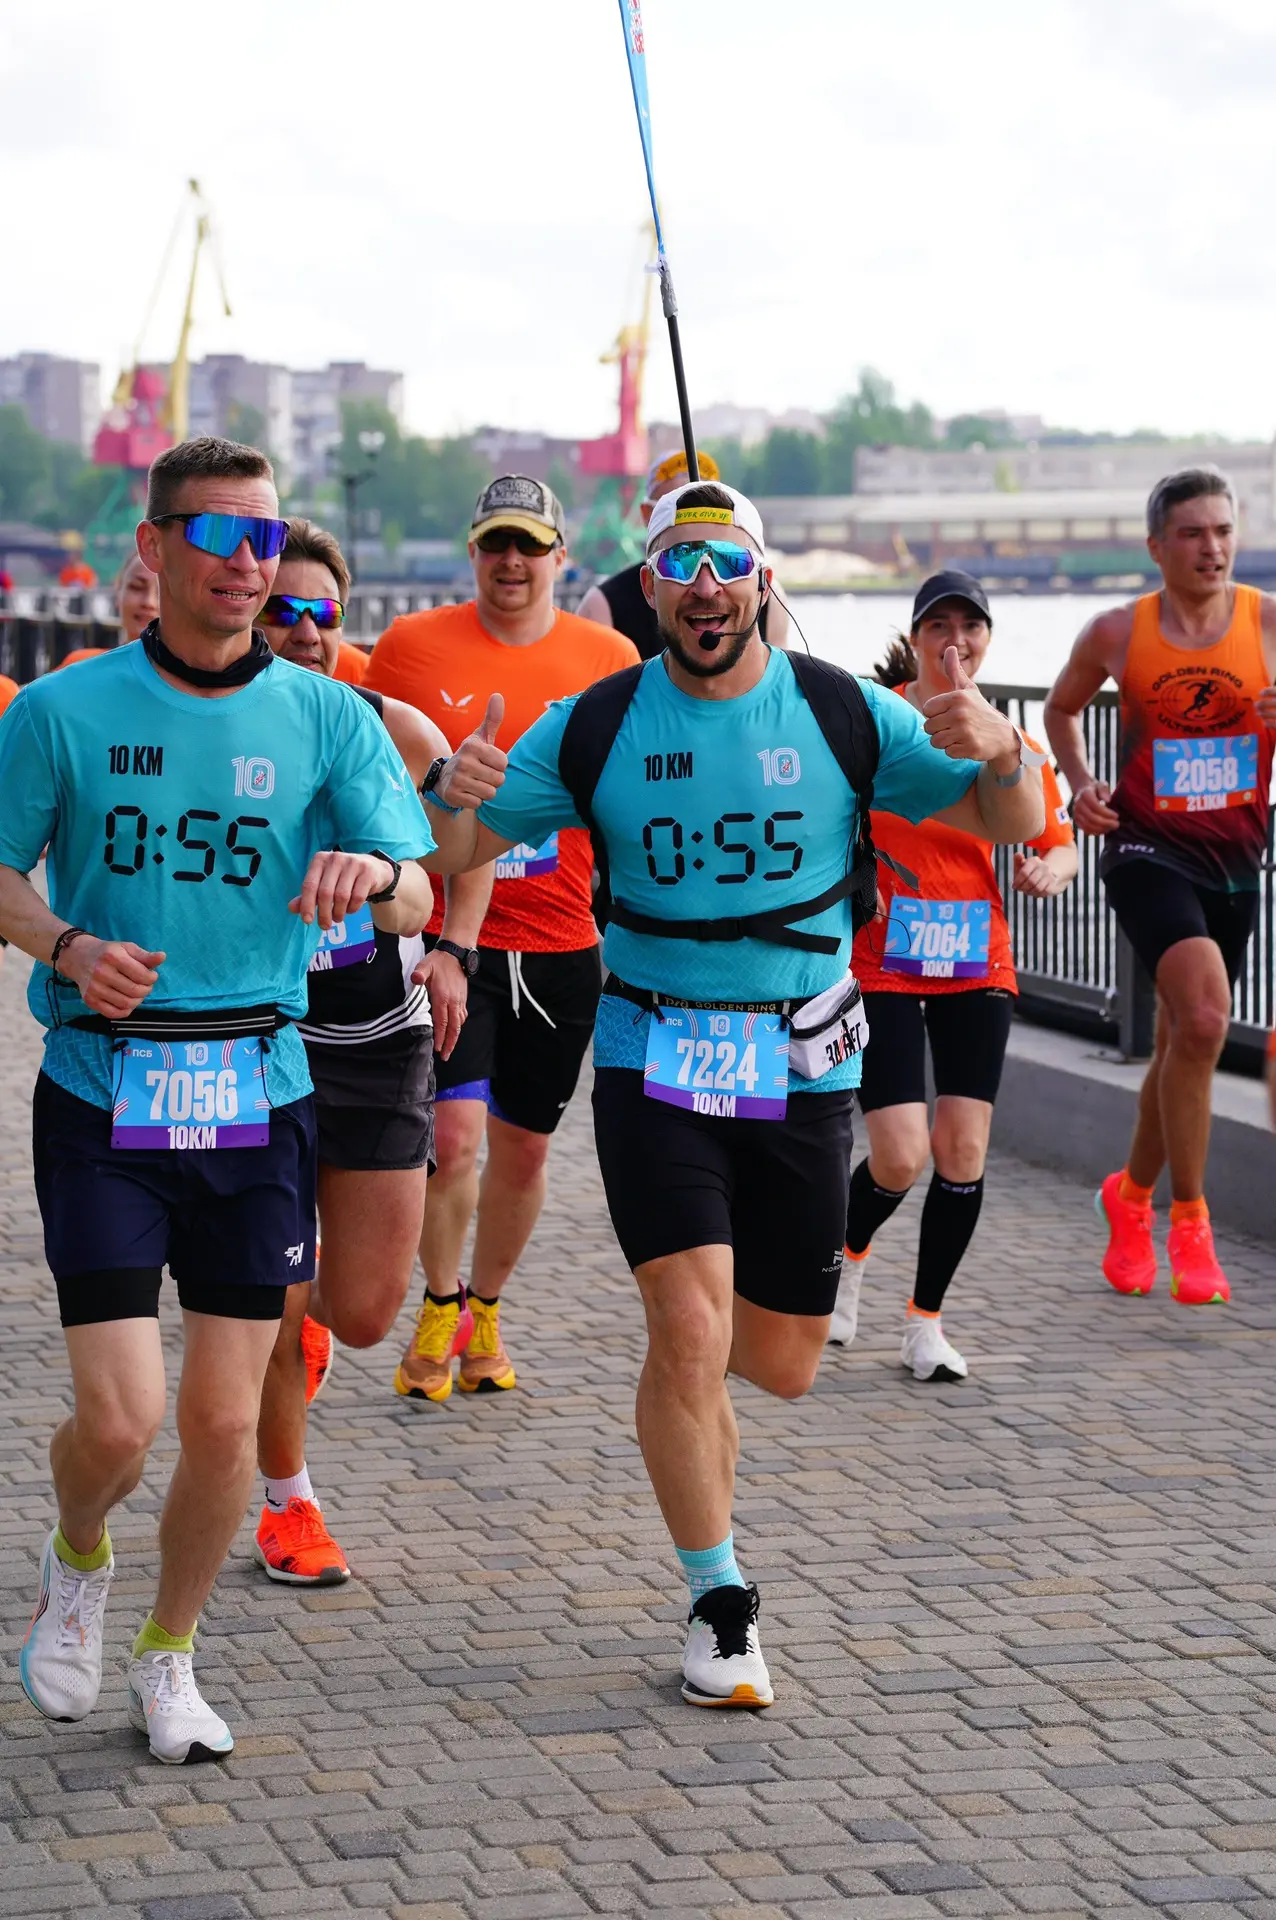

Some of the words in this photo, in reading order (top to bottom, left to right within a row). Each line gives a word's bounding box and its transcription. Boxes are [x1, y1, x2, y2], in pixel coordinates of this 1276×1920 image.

[1152, 666, 1207, 692] GOLDEN
[1210, 667, 1243, 689] RING
[1157, 713, 1205, 734] ULTRA
[1208, 710, 1247, 733] TRAIL
[108, 745, 129, 775] 10
[133, 746, 164, 776] KM
[644, 754, 663, 782] 10
[666, 752, 693, 780] KM
[757, 747, 802, 786] 10
[231, 756, 276, 799] 10
[1173, 757, 1239, 794] 2058
[104, 805, 270, 887] 0:55
[643, 810, 804, 886] 0:55
[496, 861, 526, 879] 0KM
[910, 921, 971, 958] 7064
[310, 950, 333, 972] KM
[921, 960, 955, 978] 10KM
[695, 1002, 744, 1011] GOLDEN
[748, 1003, 777, 1012] RING
[666, 1018, 683, 1026] ПСБ
[708, 1014, 731, 1036] 10
[132, 1048, 153, 1058] ПСБ
[184, 1042, 209, 1066] 10
[676, 1038, 759, 1092] 7224
[146, 1069, 239, 1122] 7056
[692, 1092, 736, 1118] 10KM
[168, 1125, 217, 1150] 10KM
